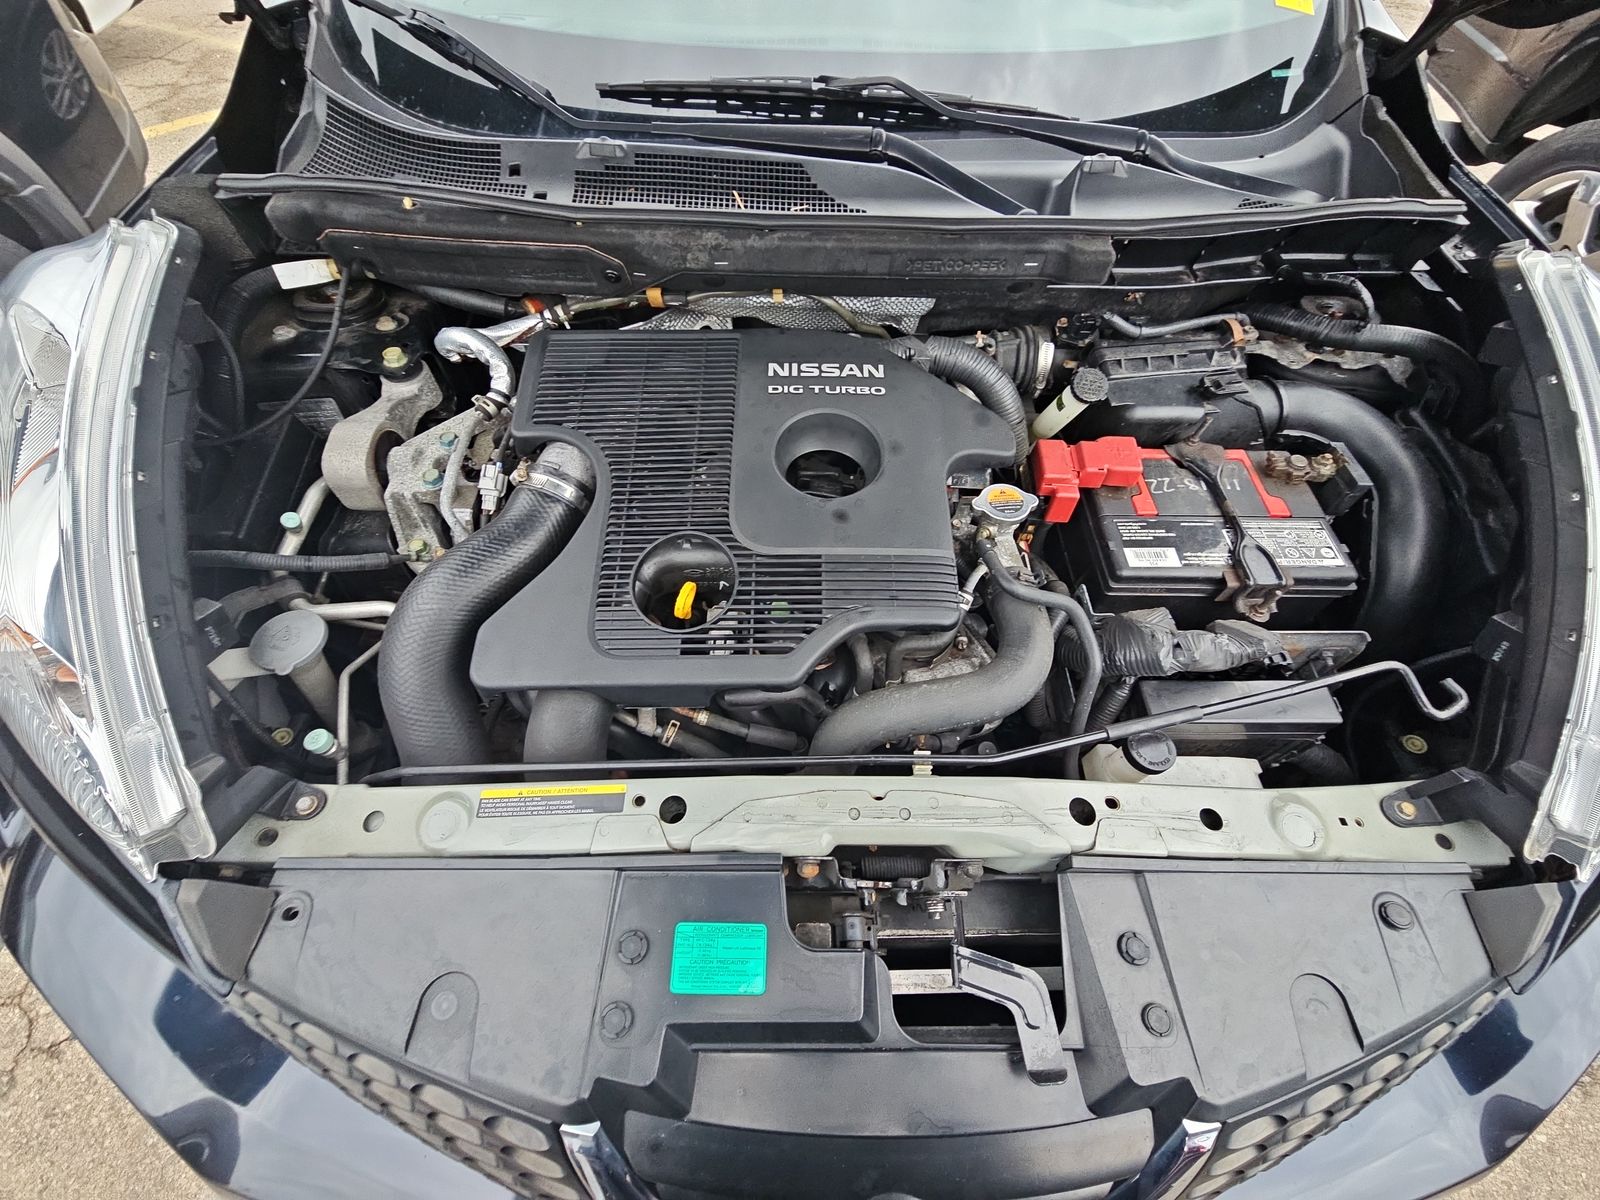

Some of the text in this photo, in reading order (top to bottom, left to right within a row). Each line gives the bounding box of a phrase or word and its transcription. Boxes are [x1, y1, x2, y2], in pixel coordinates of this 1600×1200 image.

[767, 362, 885, 378] NISSAN
[767, 385, 886, 395] DIG TURBO
